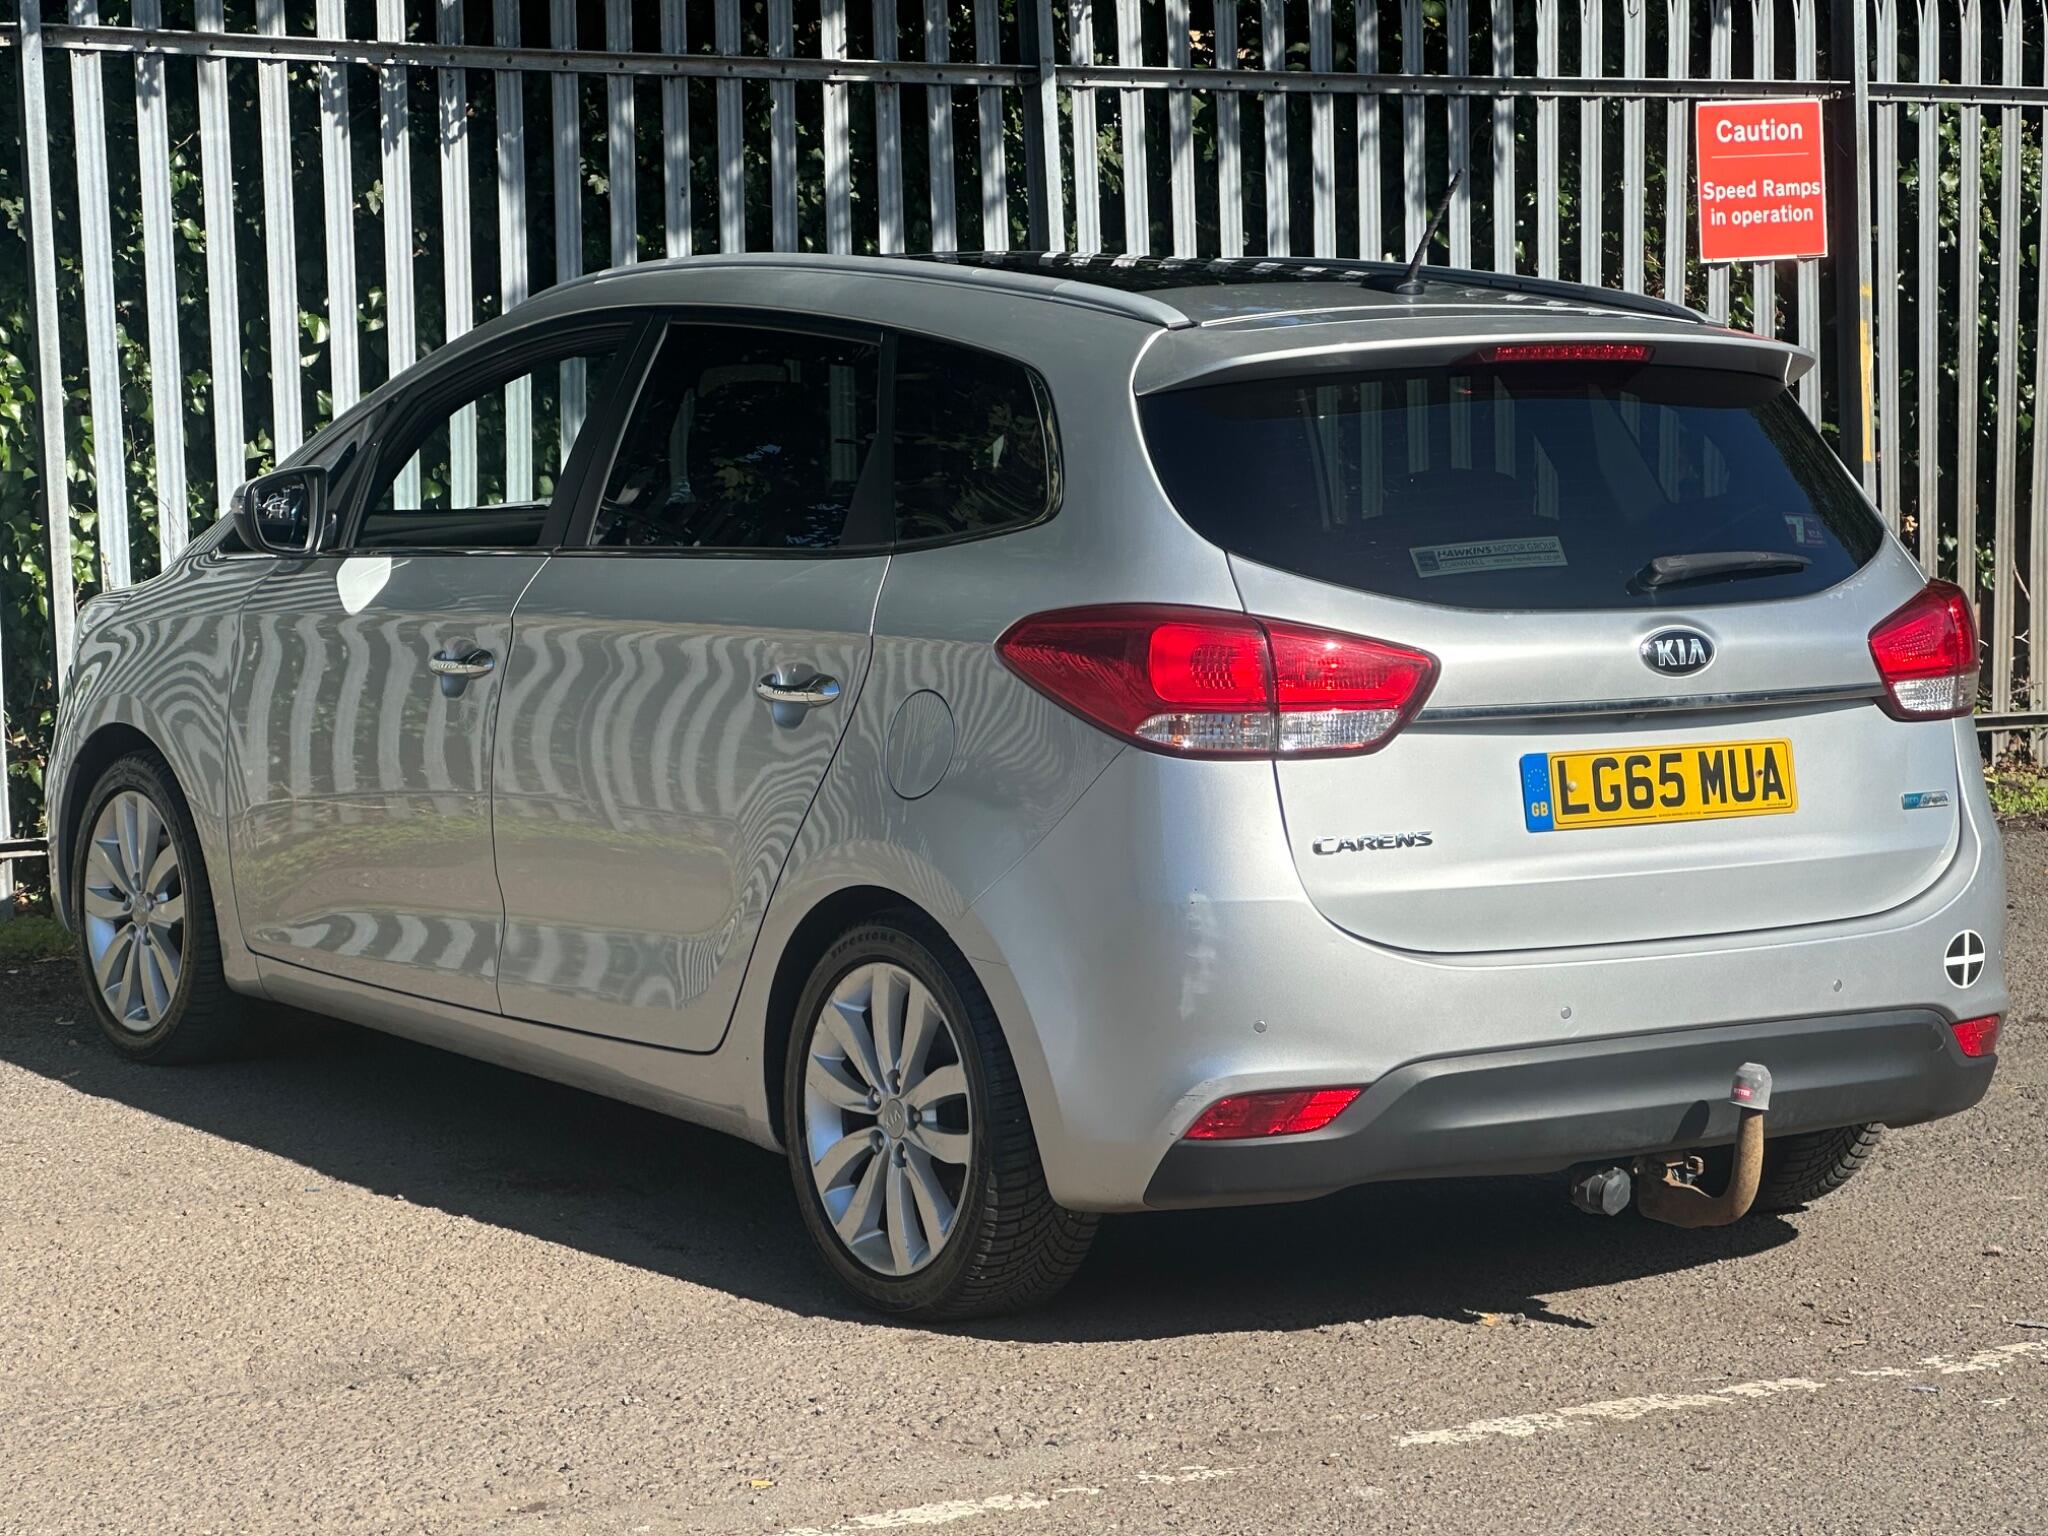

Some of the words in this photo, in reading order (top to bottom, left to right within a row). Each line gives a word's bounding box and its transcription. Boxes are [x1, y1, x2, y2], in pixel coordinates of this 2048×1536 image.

[1715, 118, 1803, 144] Caution
[1702, 179, 1757, 202] Speed
[1762, 179, 1821, 199] Ramps
[1710, 207, 1727, 226] in
[1731, 204, 1814, 228] operation
[1437, 546, 1492, 558] HAWKINS
[1493, 543, 1525, 553] MOTOR
[1526, 541, 1557, 552] GROUP
[1654, 638, 1707, 666] KIA
[1557, 752, 1686, 815] LG65
[1698, 747, 1786, 805] MUA
[1531, 801, 1549, 817] GB
[1312, 830, 1433, 856] CARENS
